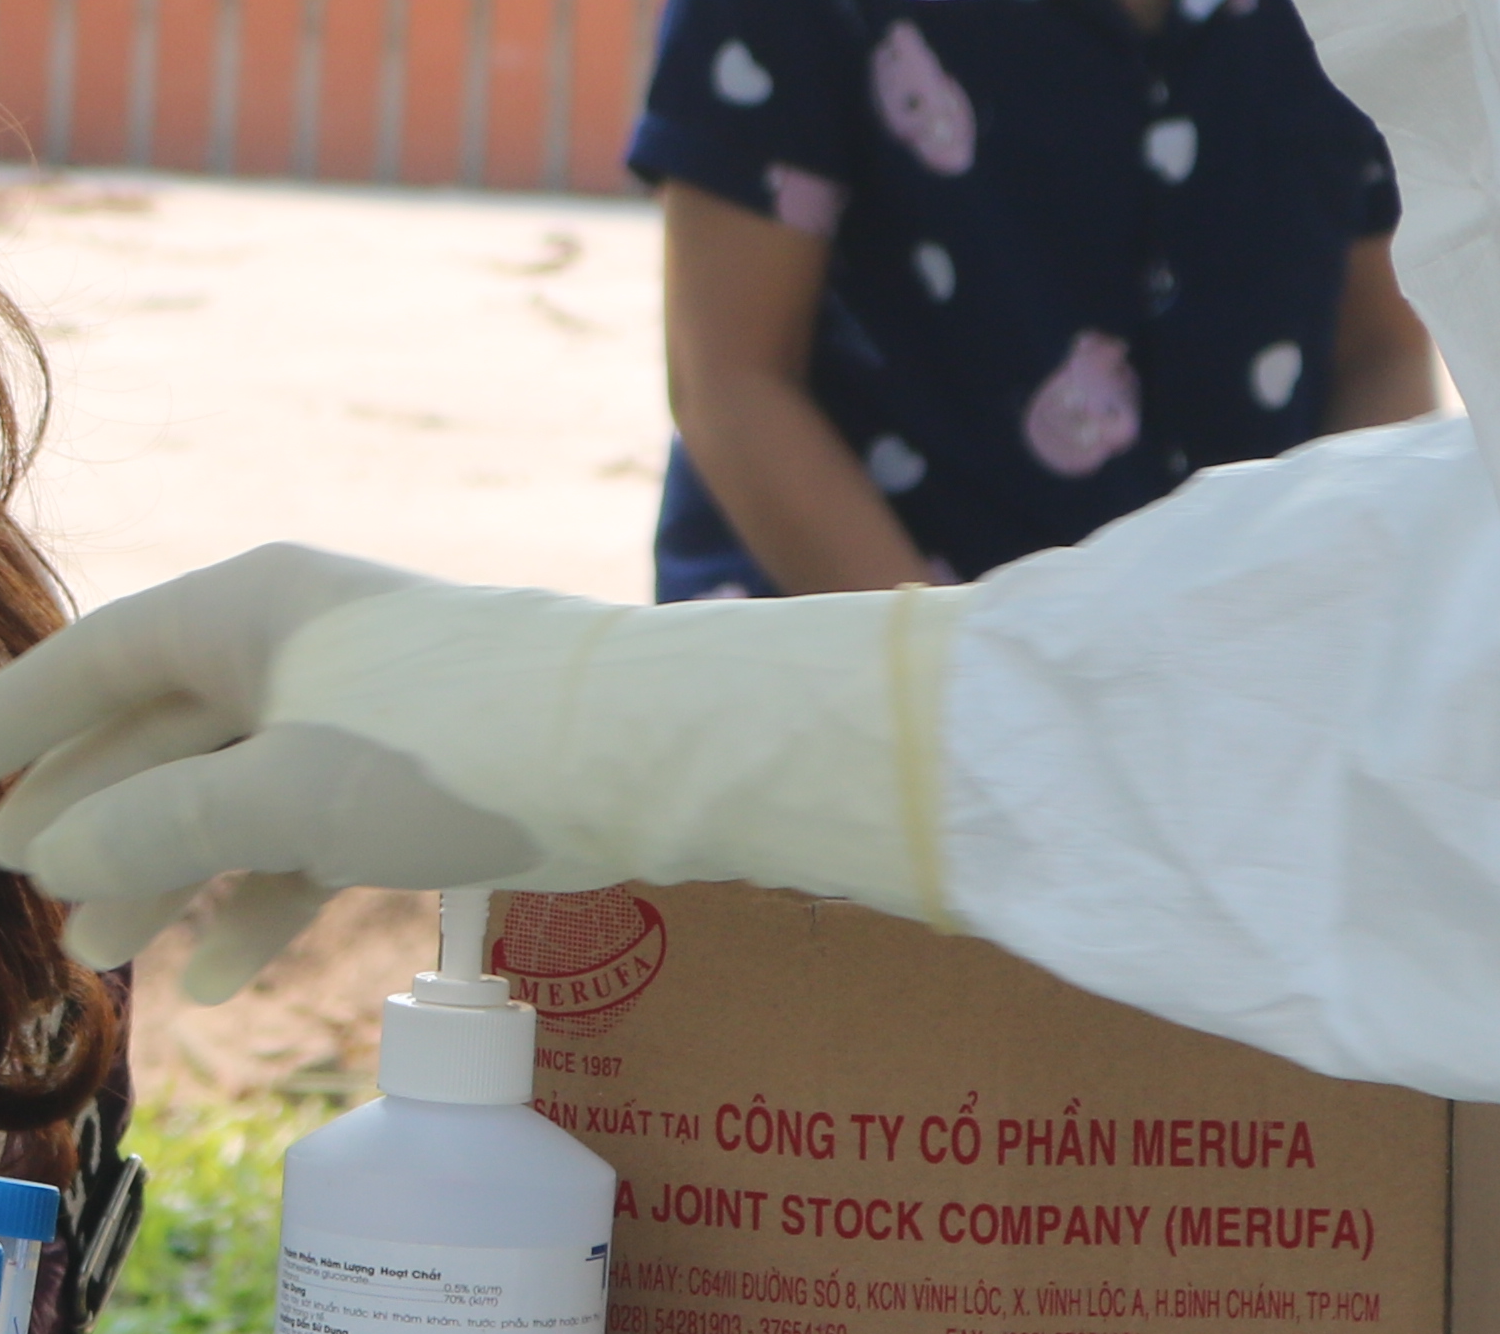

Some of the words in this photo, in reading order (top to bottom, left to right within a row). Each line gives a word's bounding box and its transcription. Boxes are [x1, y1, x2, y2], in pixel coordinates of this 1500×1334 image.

[518, 955, 654, 1007] MERUFA
[535, 1047, 576, 1073] INCE
[582, 1055, 622, 1077] 1987
[586, 1099, 652, 1136] XUẤT
[660, 1111, 699, 1144] TẠI
[715, 1093, 835, 1160] CÔNG
[850, 1113, 905, 1162] TY
[919, 1090, 981, 1165] CỔ
[997, 1097, 1116, 1167] PHẦN
[1132, 1118, 1316, 1169] MERUFA
[652, 1182, 768, 1231] JOINT
[781, 1194, 924, 1242] STOCK
[939, 1202, 1151, 1247] COMPANY
[1165, 1205, 1375, 1262] (MERUFA)
[845, 1281, 861, 1312] 8,
[867, 1281, 906, 1310] KCN
[1013, 1287, 1031, 1316] X.
[1306, 1291, 1380, 1322] TP.HCM
